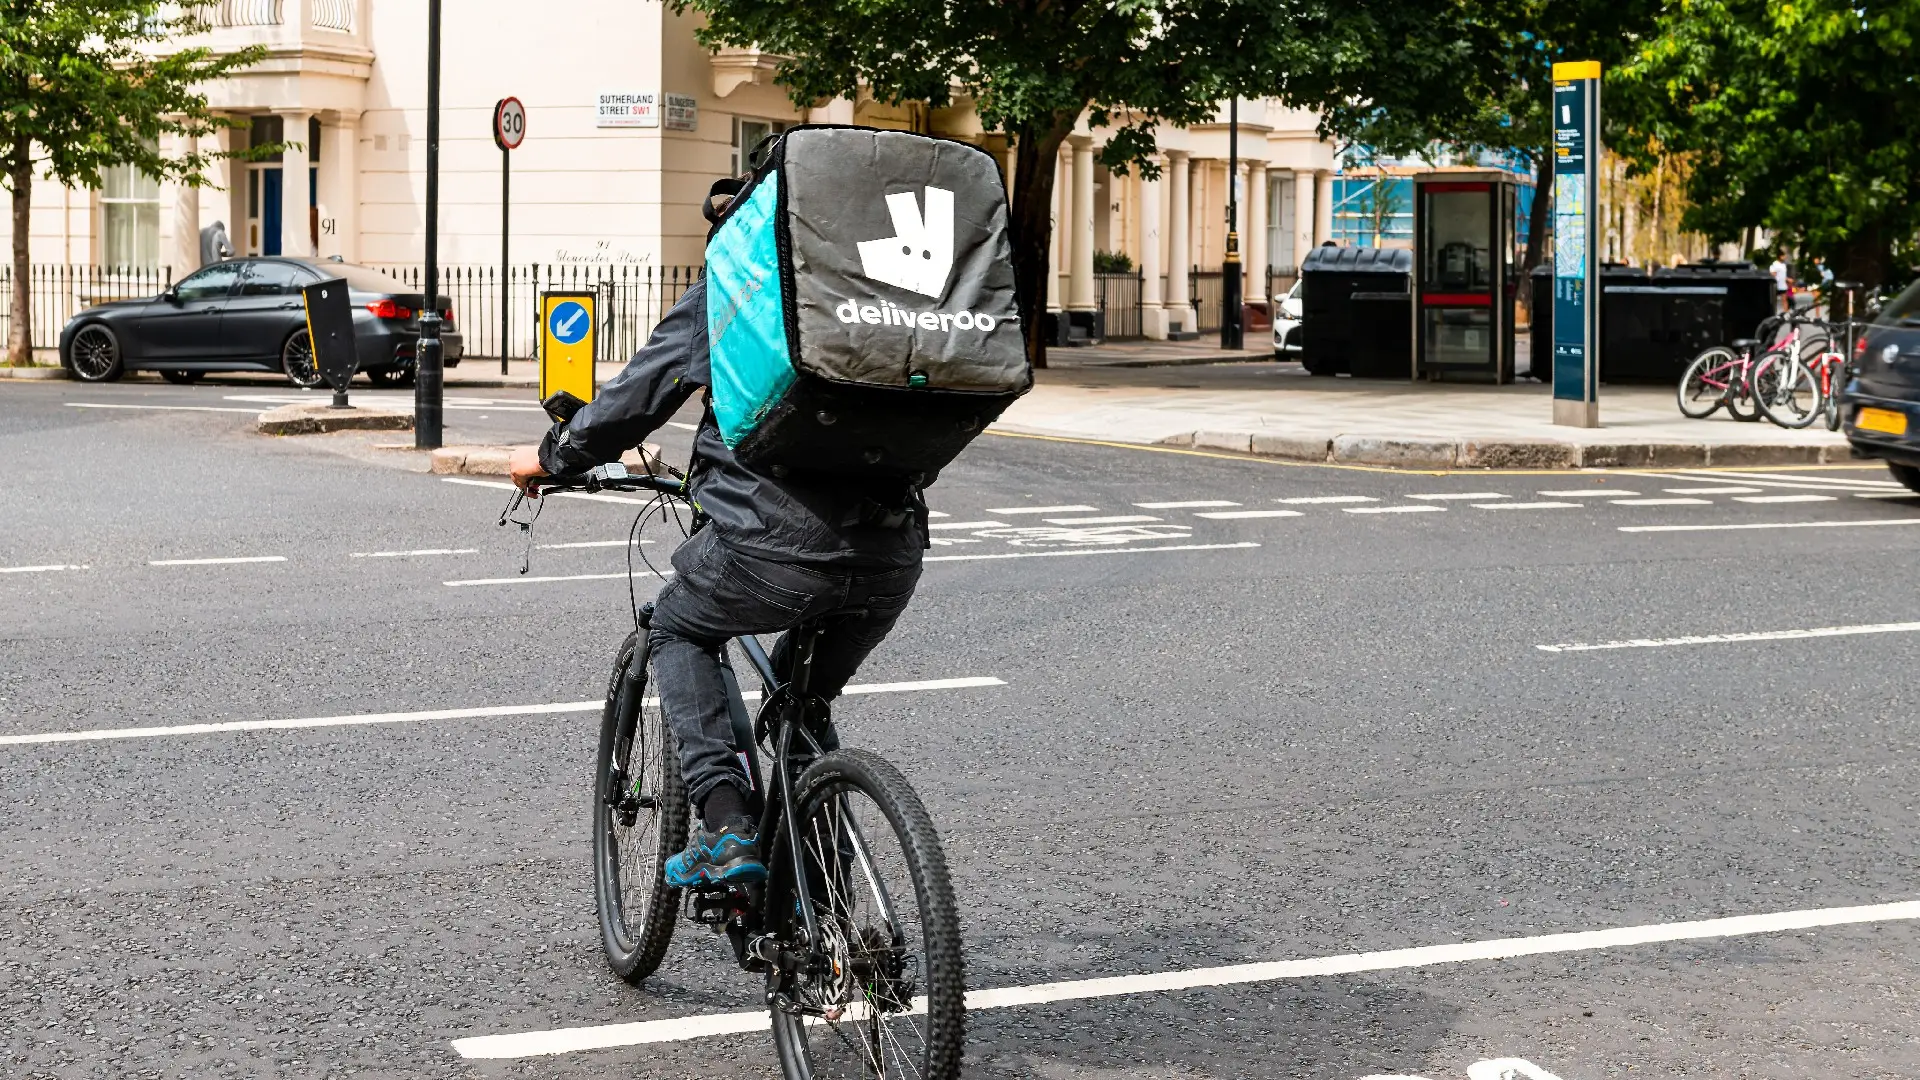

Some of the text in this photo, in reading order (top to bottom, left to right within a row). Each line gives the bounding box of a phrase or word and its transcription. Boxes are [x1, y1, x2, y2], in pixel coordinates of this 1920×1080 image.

[600, 95, 653, 104] SUTHERLAND
[600, 106, 650, 115] STREET SW1
[503, 112, 523, 134] 30
[322, 218, 335, 235] 91
[596, 240, 610, 250] 91
[835, 298, 996, 333] deliveroo
